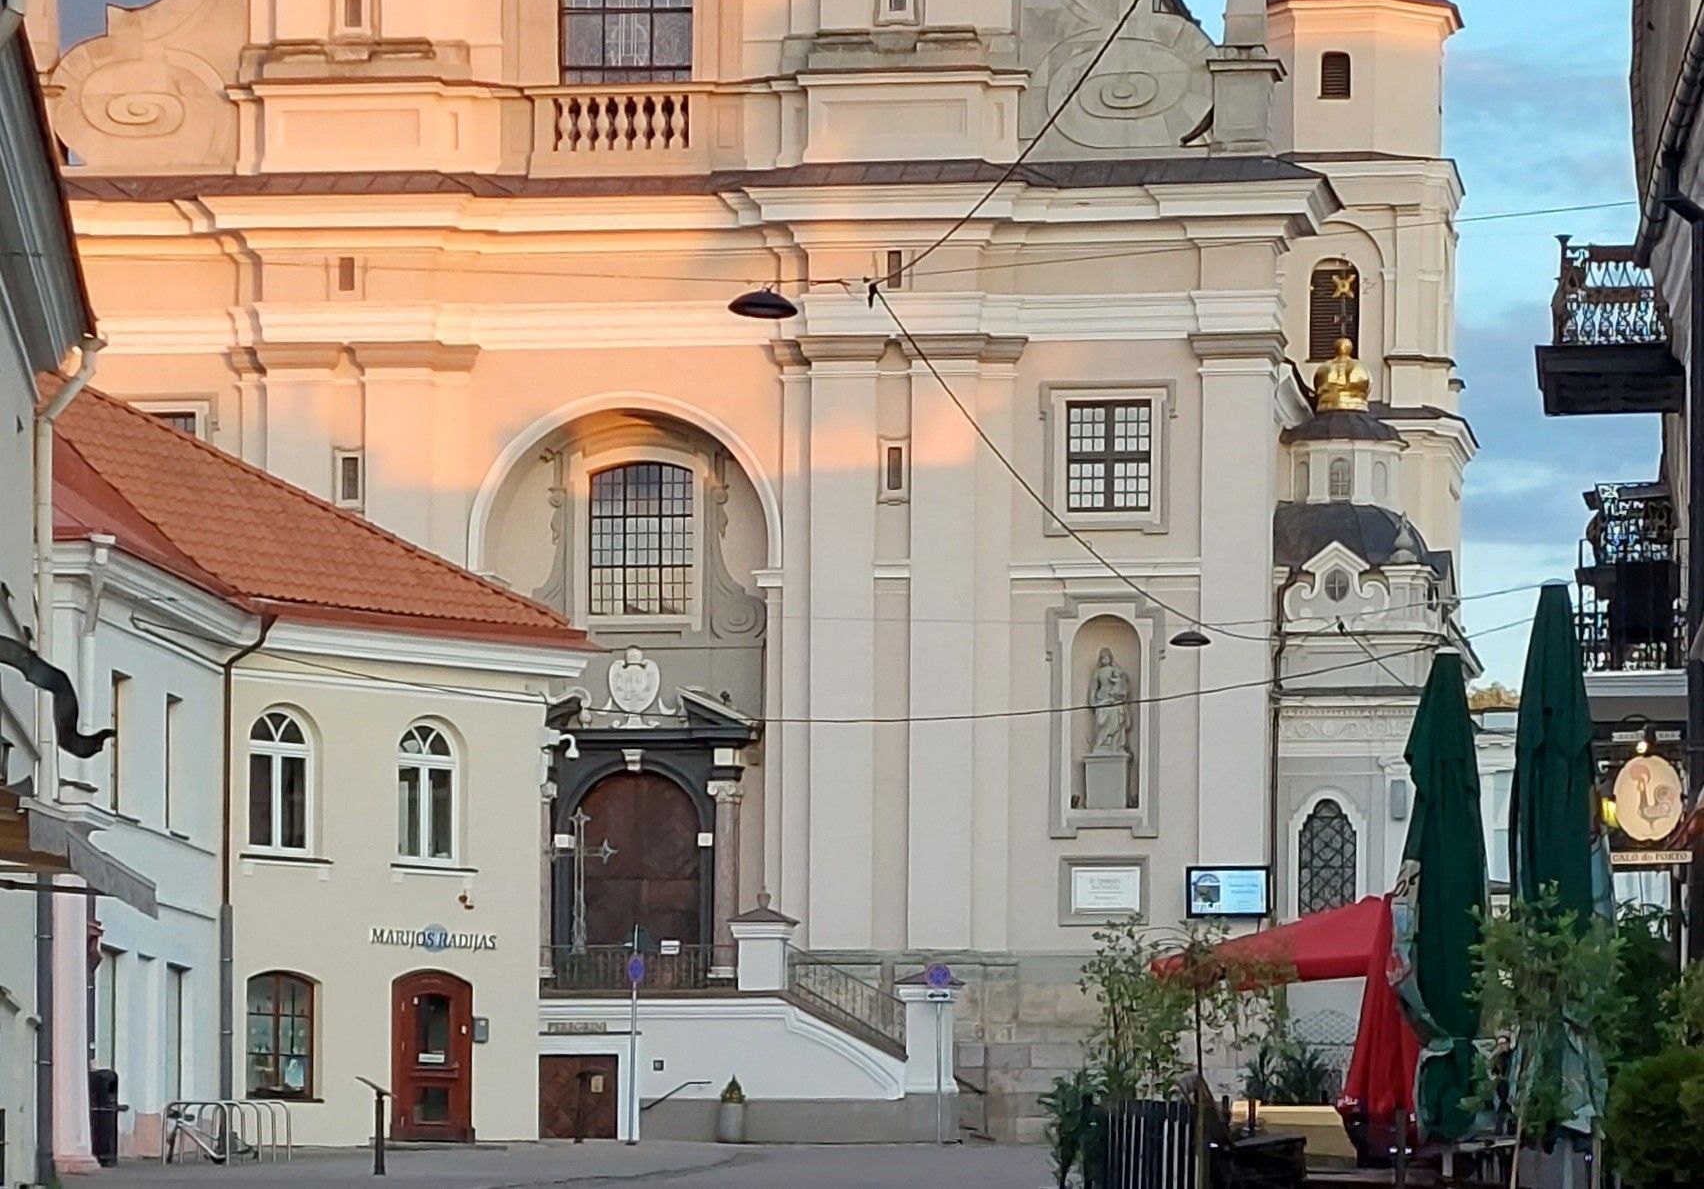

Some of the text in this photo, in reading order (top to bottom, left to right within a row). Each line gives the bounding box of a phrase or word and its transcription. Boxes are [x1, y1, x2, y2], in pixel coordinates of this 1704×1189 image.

[1612, 854, 1639, 862] GALO
[1655, 852, 1688, 860] PORTO
[371, 928, 497, 952] MARIJOS RADIJAS
